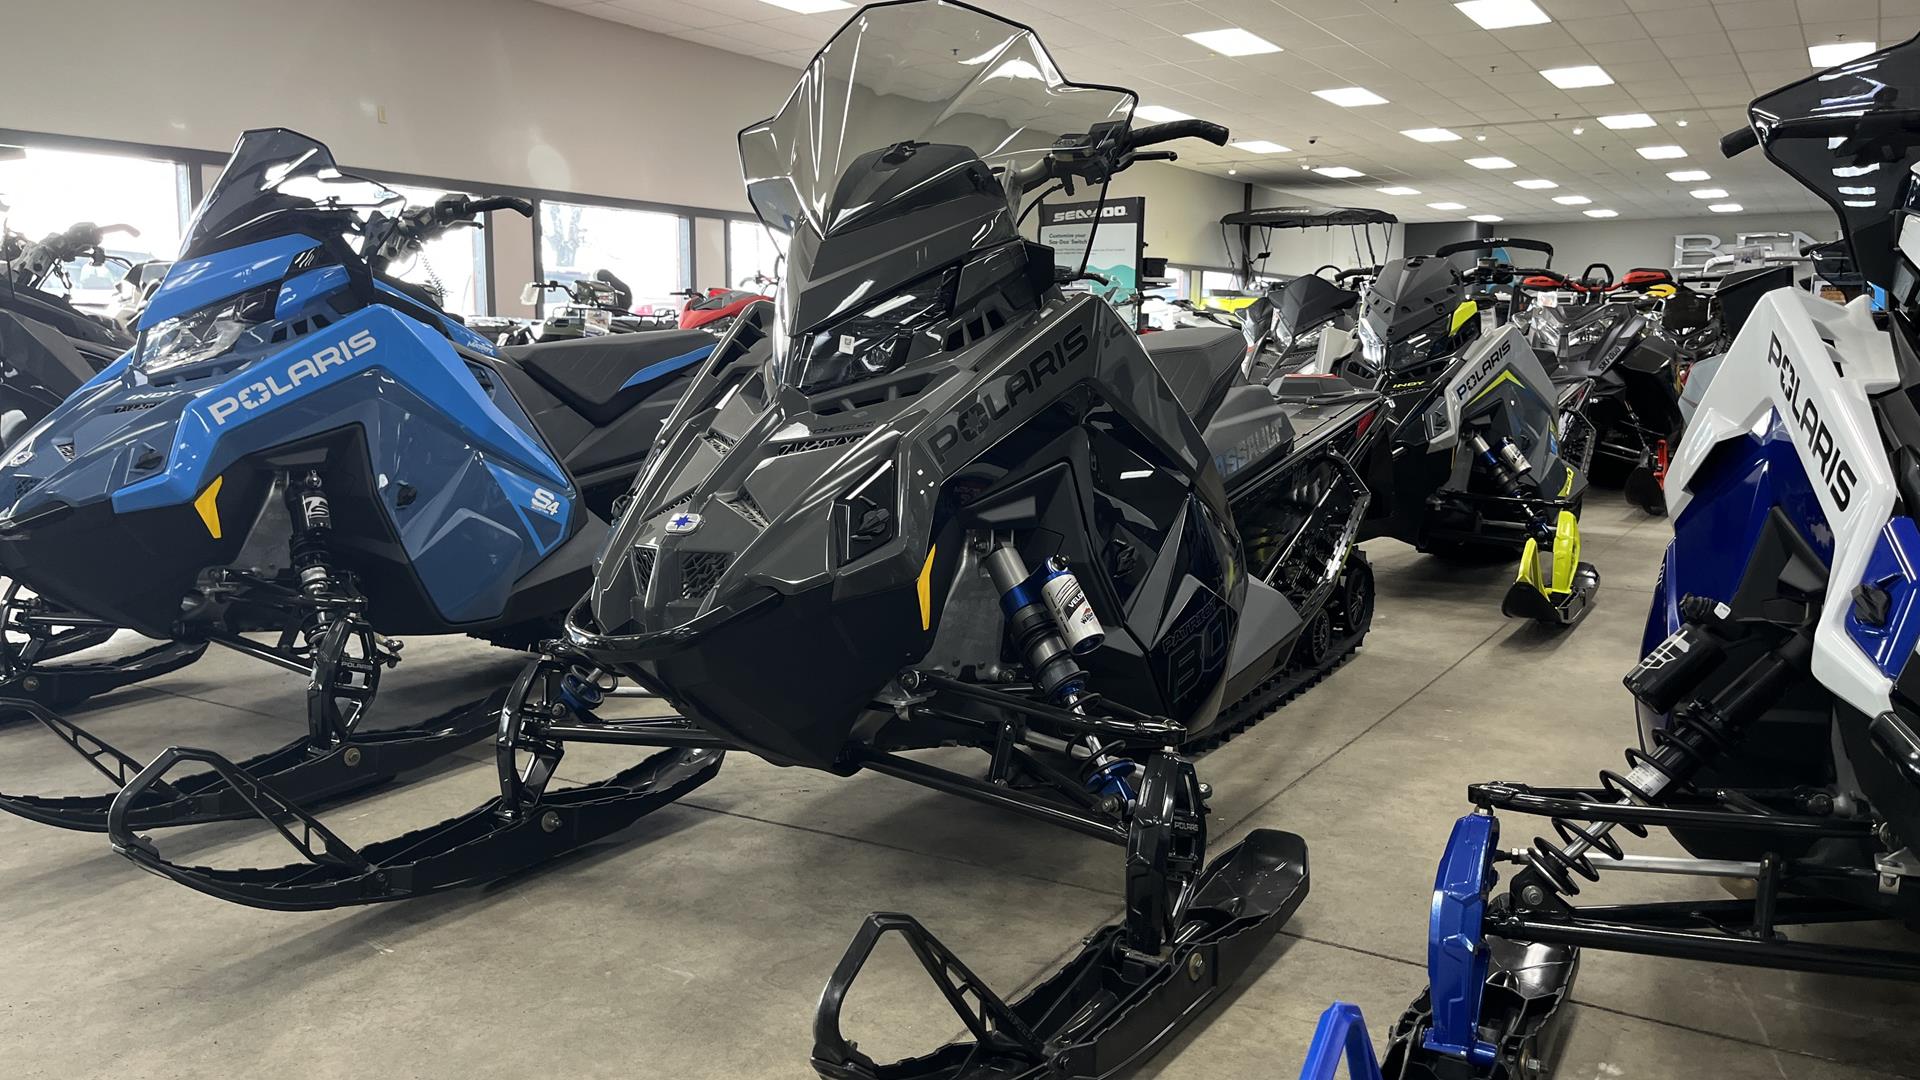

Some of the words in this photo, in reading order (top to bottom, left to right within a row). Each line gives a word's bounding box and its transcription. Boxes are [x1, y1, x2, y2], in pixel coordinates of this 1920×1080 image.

[126, 389, 184, 401] INDY
[206, 329, 377, 425] POLARIS
[928, 325, 1089, 465] POLARIS
[1392, 380, 1426, 389] INDY
[1456, 339, 1511, 401] POLARIS
[1215, 417, 1282, 479] ASSAULT
[1767, 330, 1858, 512] POLARIS
[531, 487, 560, 516] S4
